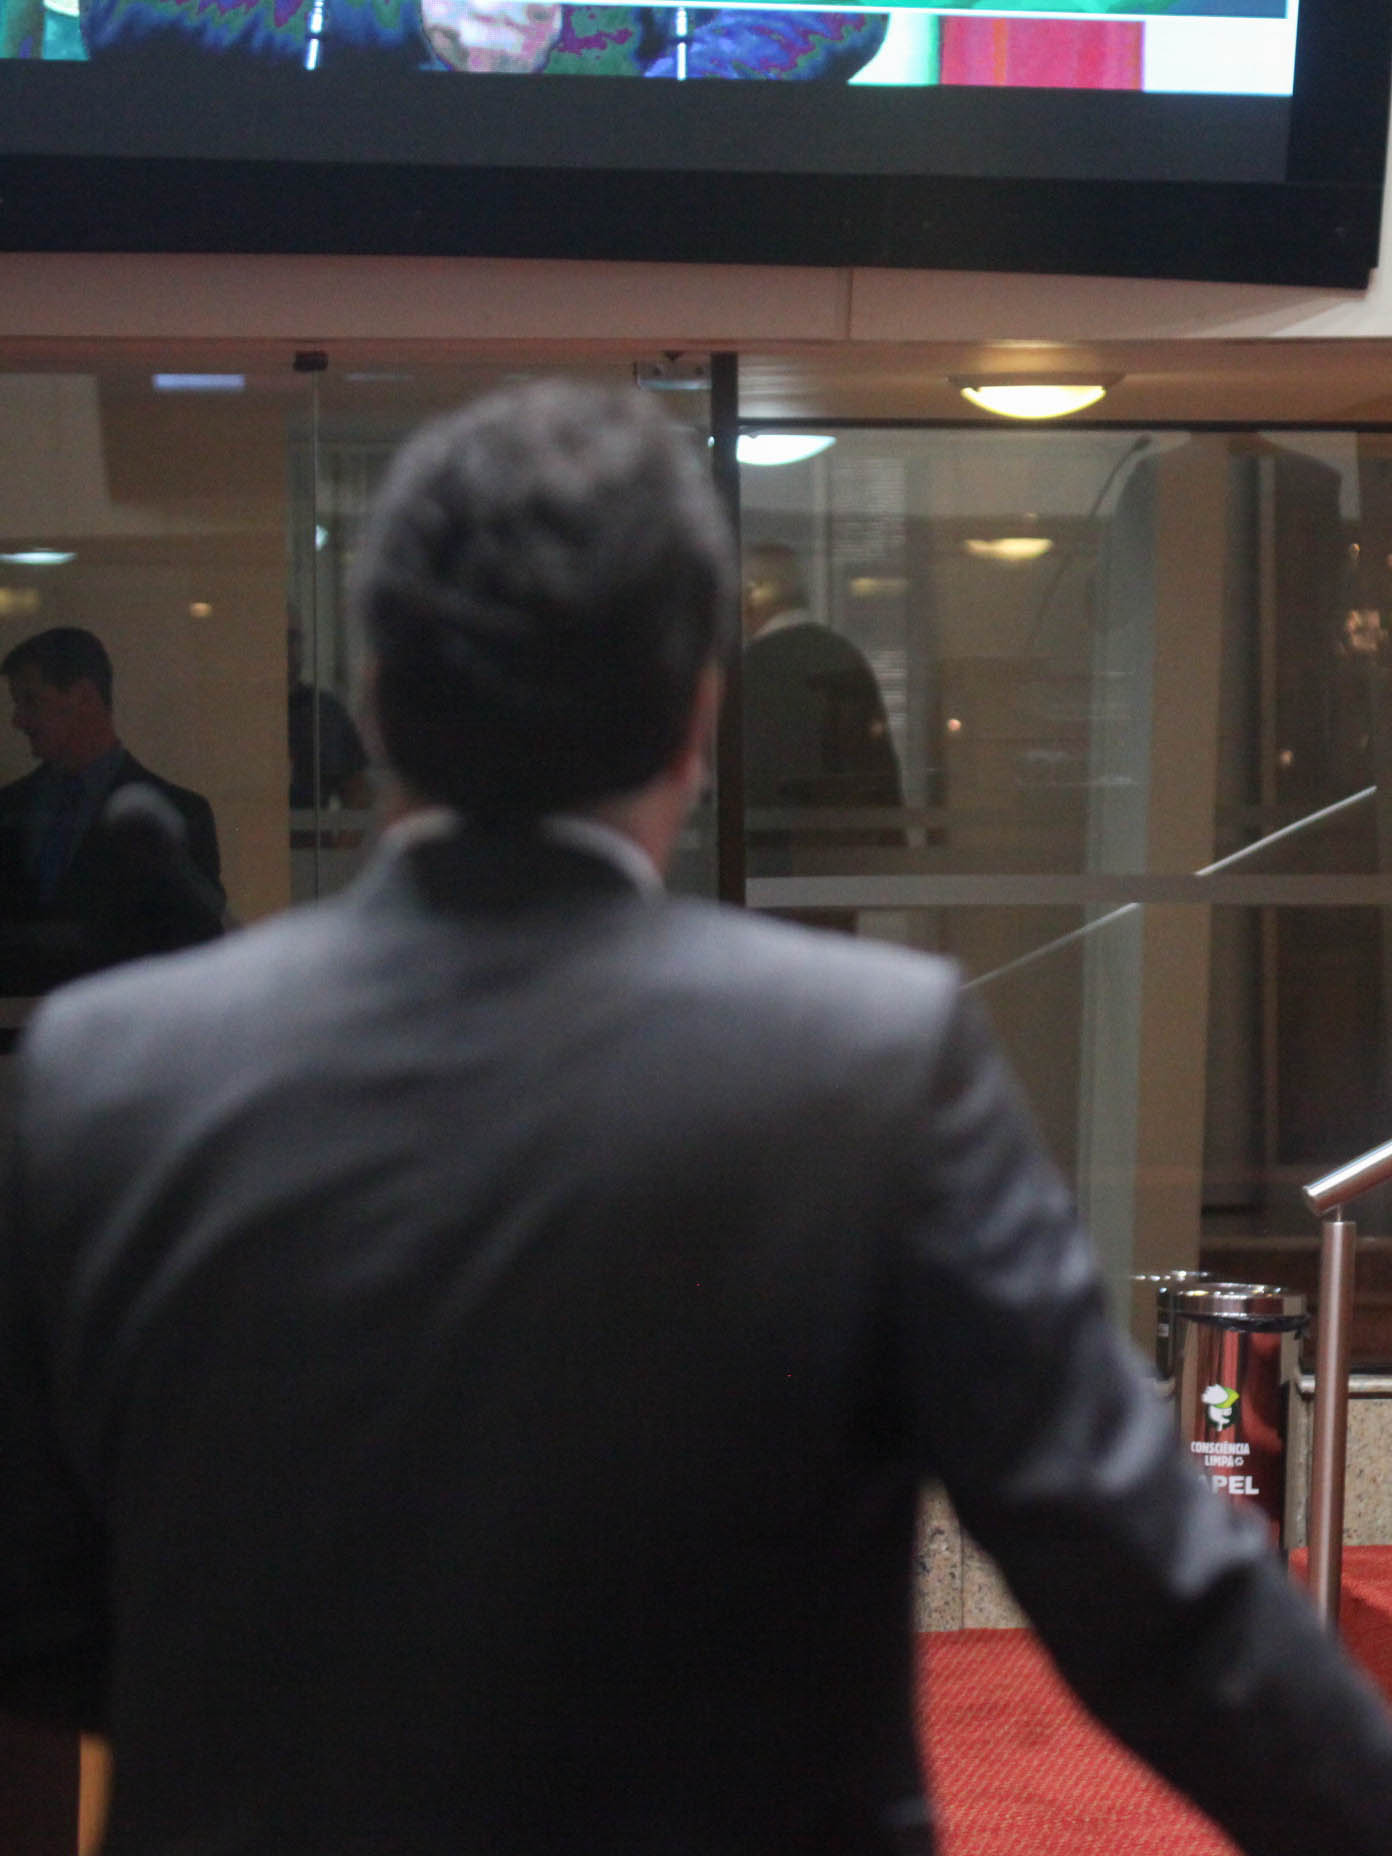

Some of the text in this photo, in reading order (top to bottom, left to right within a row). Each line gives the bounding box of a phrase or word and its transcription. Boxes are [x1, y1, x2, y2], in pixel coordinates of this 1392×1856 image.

[1190, 1440, 1250, 1455] CONSCIÊNCIA
[1204, 1454, 1234, 1467] LIMPA
[1207, 1475, 1260, 1495] PEL
